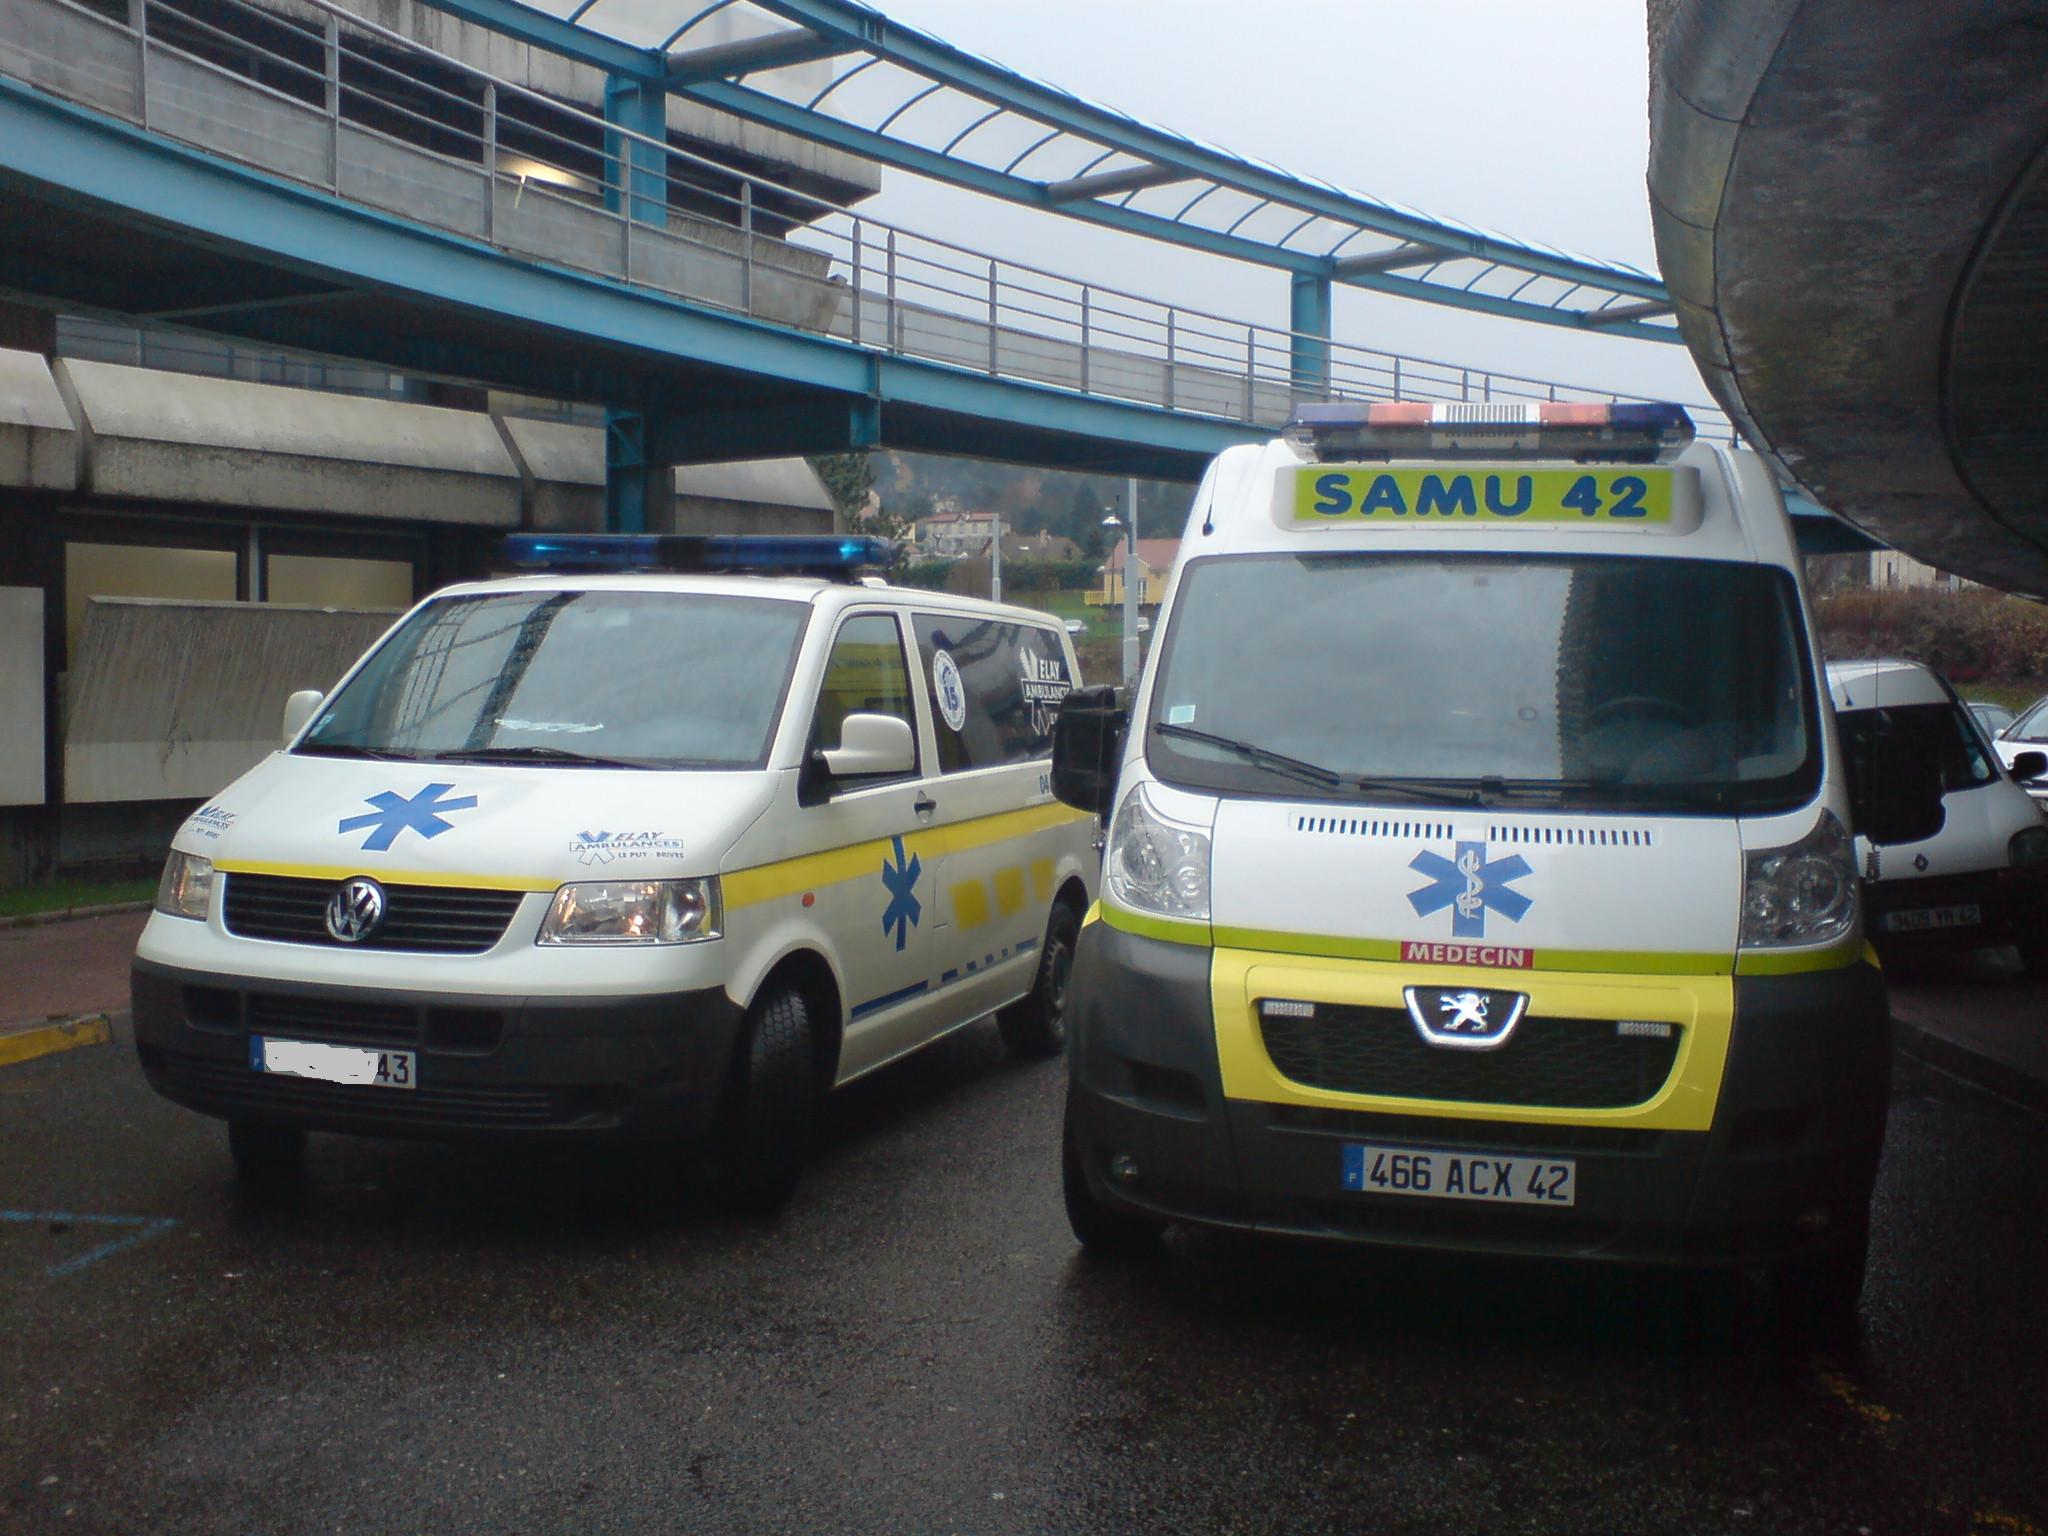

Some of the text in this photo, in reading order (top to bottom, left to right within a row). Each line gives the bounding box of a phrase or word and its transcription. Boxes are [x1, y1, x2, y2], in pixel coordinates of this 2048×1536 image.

[1313, 474, 1648, 518] SAMU 42
[944, 686, 959, 712] 15
[575, 840, 680, 850] AMBULANCES
[1408, 942, 1524, 967] MEDECIN
[378, 1053, 409, 1084] 43
[1370, 1153, 1432, 1191] 466
[1446, 1159, 1513, 1197] ACX
[1527, 1164, 1569, 1200] 42
